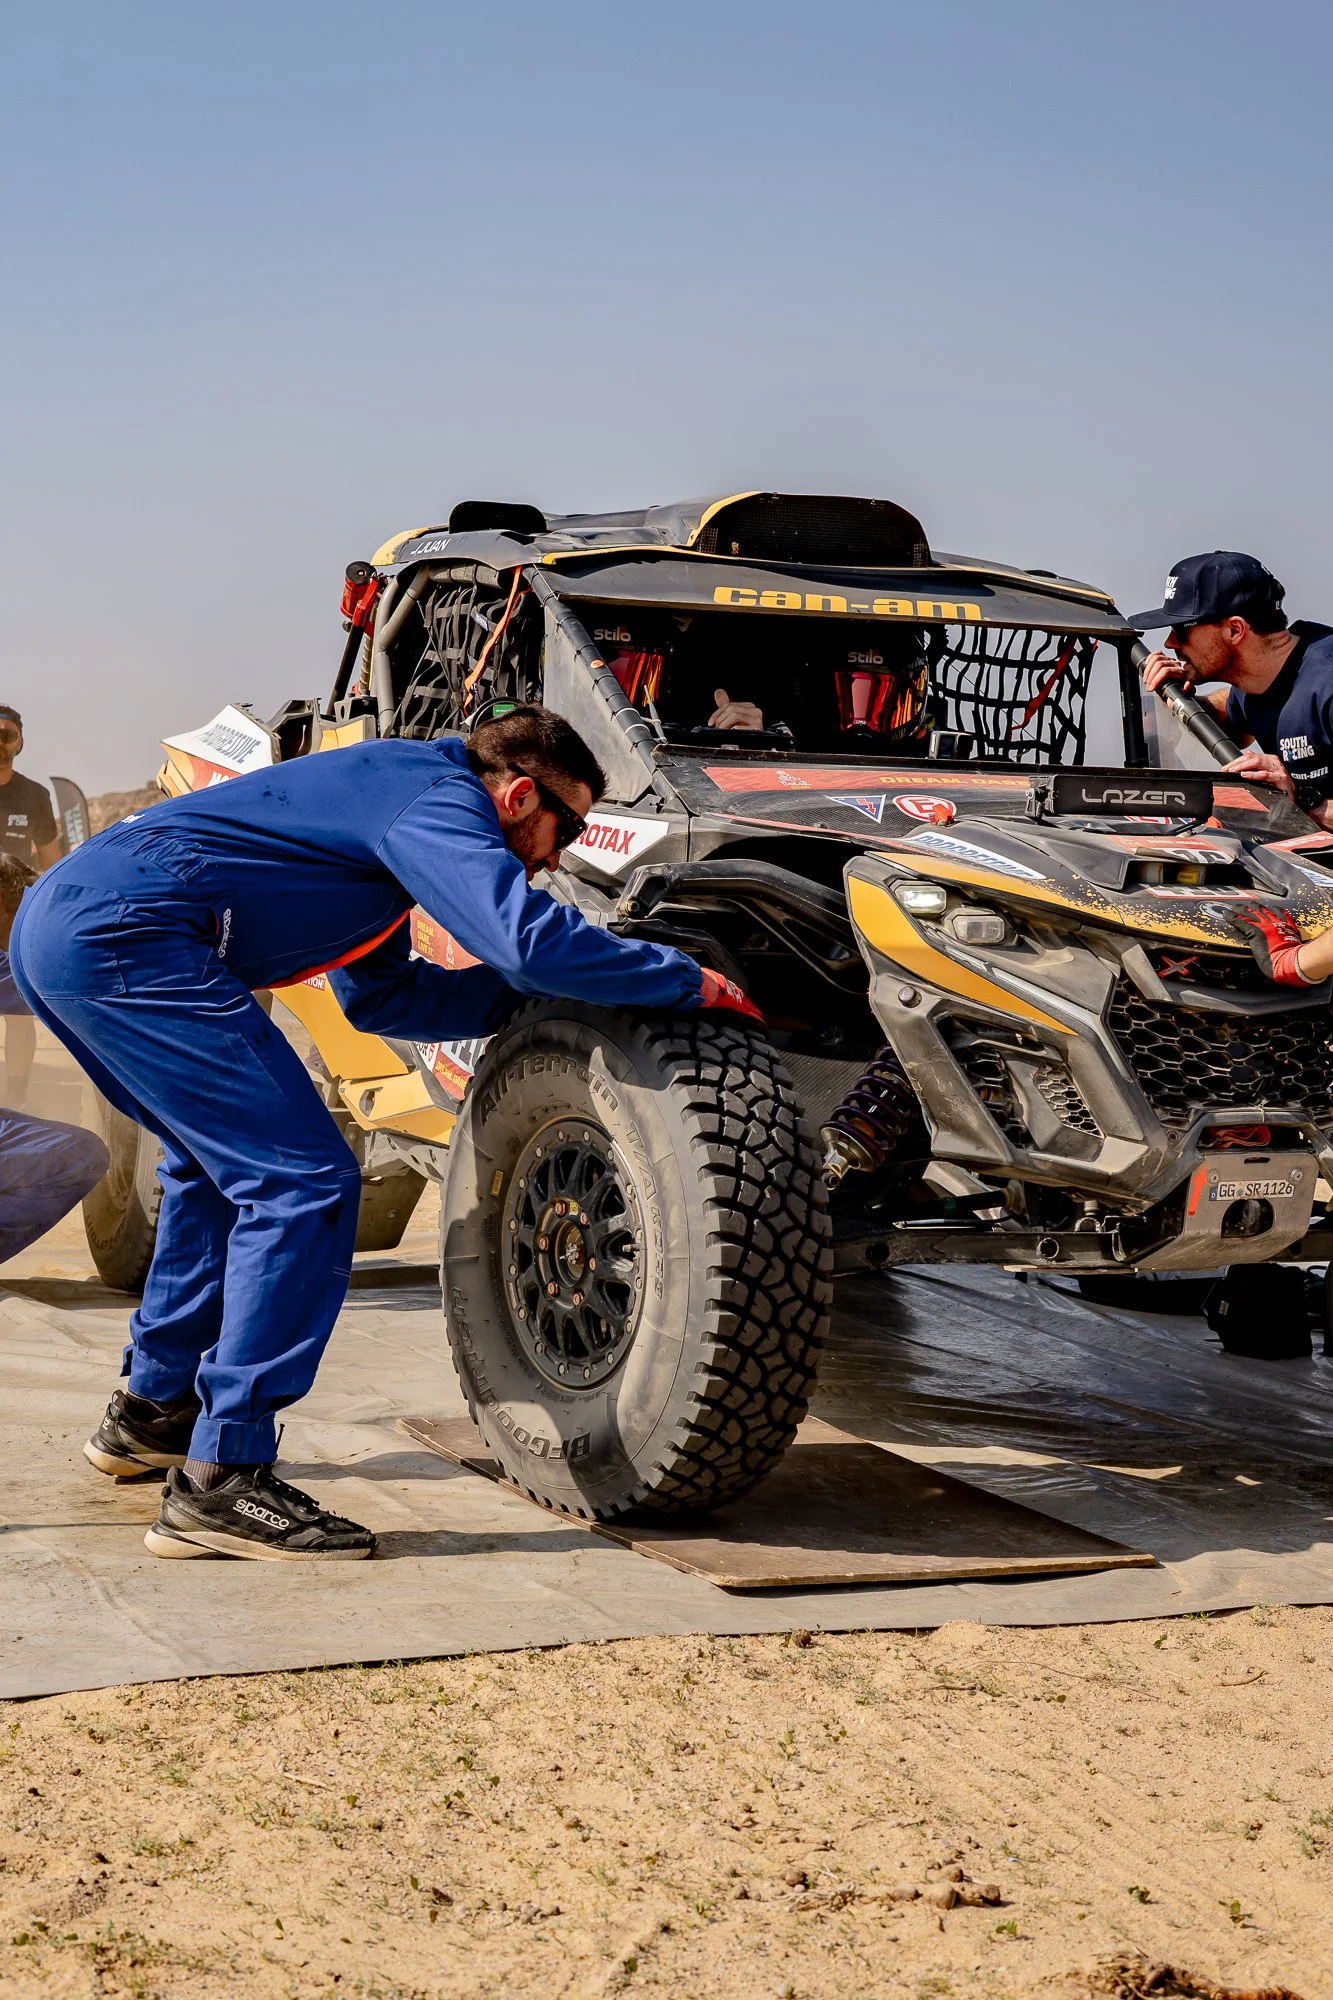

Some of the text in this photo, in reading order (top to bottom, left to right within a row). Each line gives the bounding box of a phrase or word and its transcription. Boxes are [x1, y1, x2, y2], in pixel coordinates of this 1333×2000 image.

[713, 586, 983, 620] can-am
[1279, 735, 1308, 751] SOUTH
[1081, 788, 1186, 806] LAZER
[479, 1053, 620, 1127] All-Terrain
[1219, 1184, 1235, 1198] GG
[1245, 1183, 1260, 1197] SR
[1263, 1182, 1293, 1196] 1126
[233, 1498, 290, 1530] sparco
